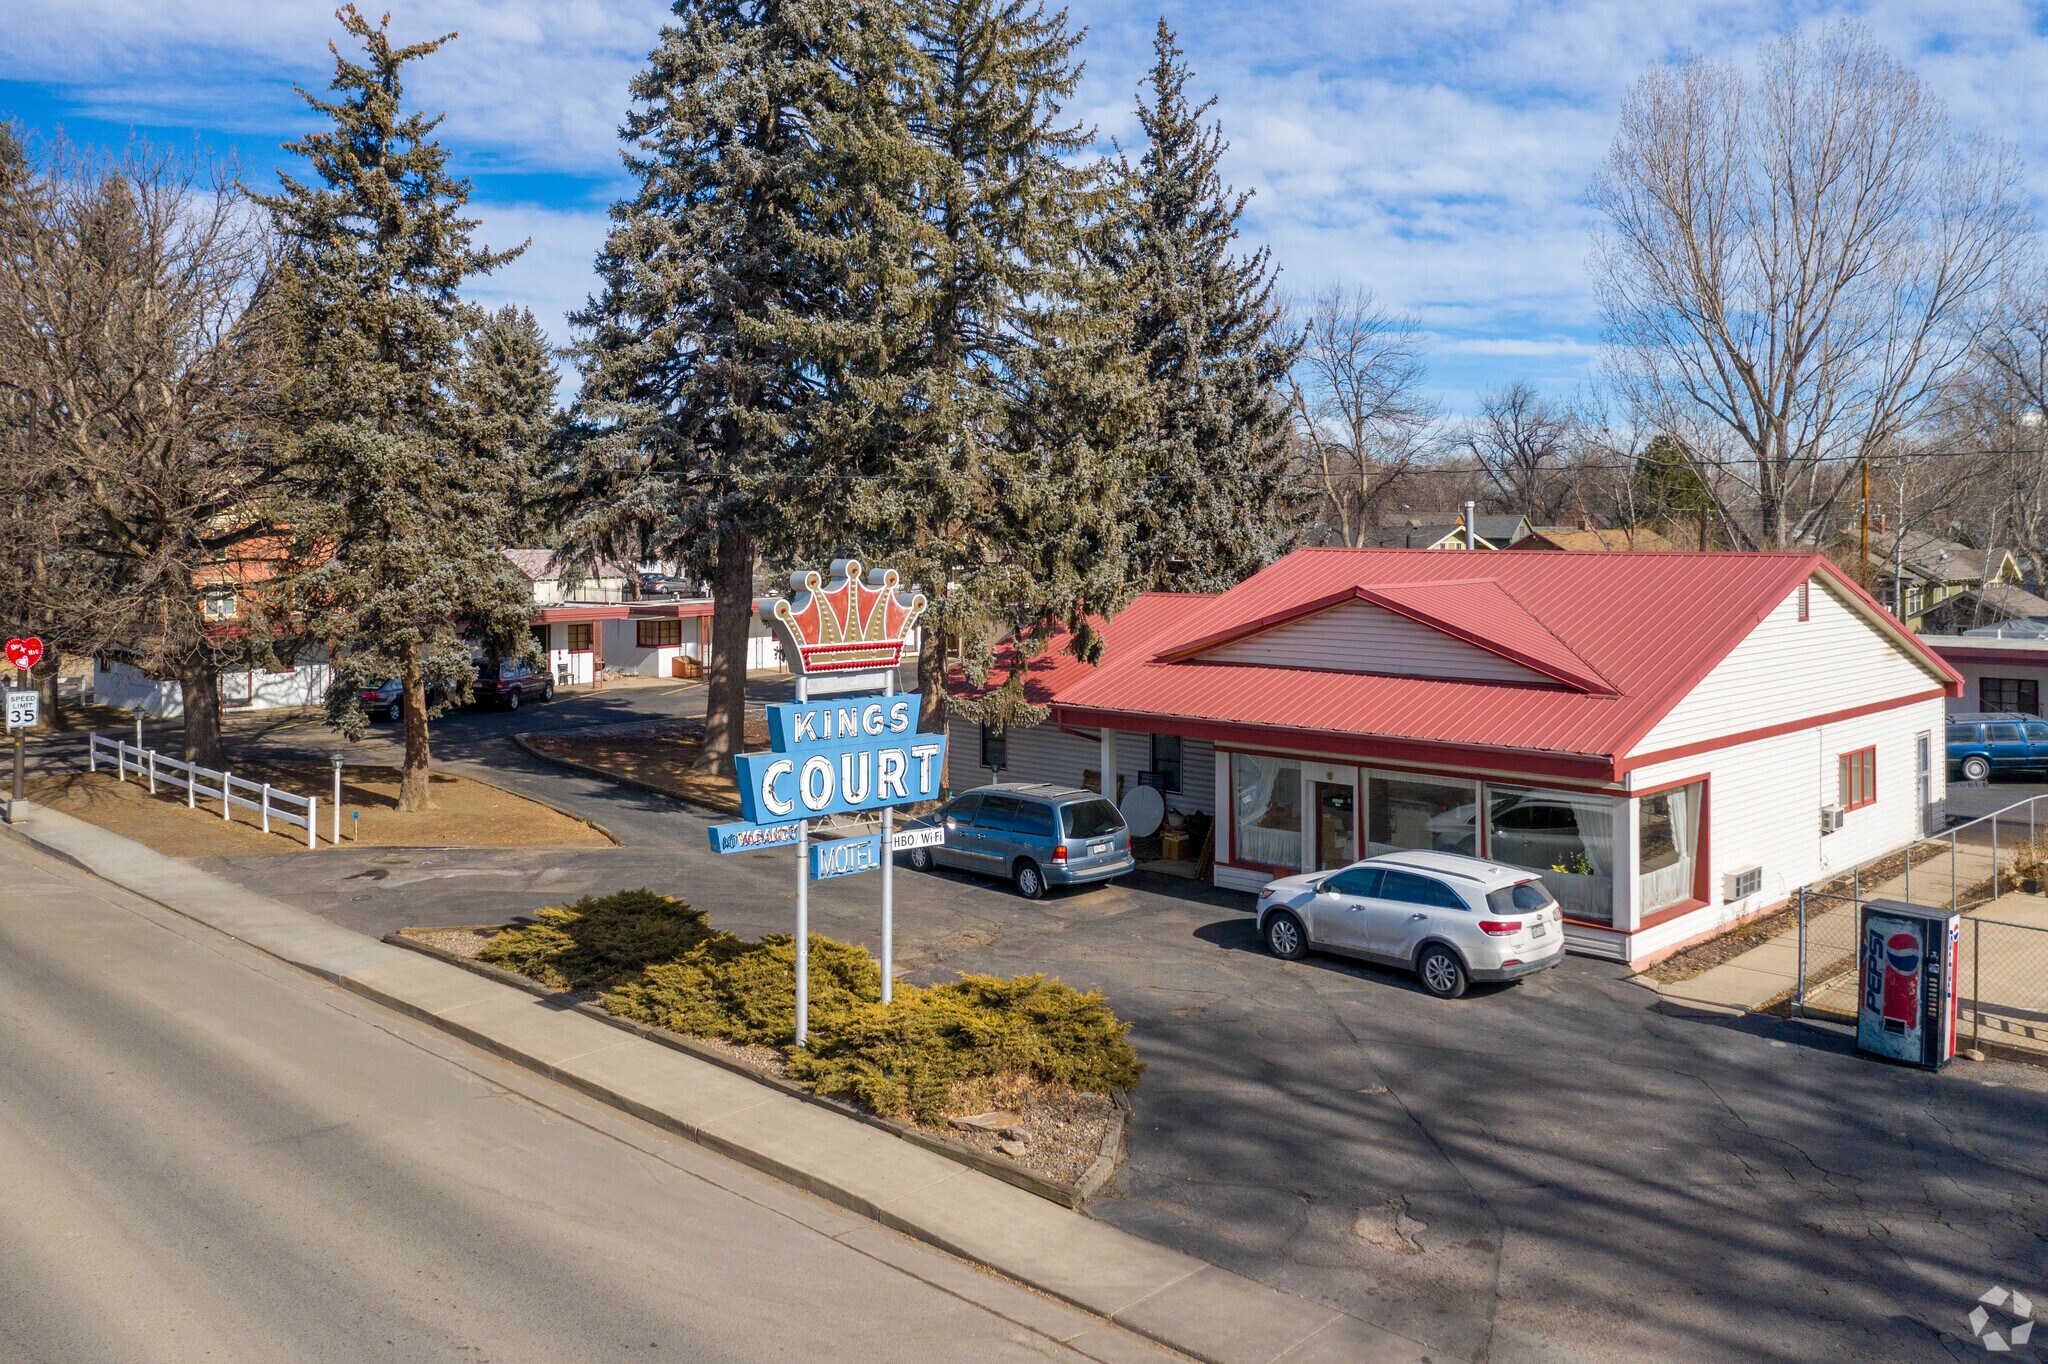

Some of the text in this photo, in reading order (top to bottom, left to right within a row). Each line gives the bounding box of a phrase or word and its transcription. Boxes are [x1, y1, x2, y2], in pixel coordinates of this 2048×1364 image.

[11, 710, 34, 722] 35
[794, 702, 909, 743] KINGS
[761, 743, 940, 816] COURT
[736, 823, 799, 848] VACANCY
[893, 834, 915, 848] HBO
[820, 840, 878, 877] MOTEL
[1866, 929, 1884, 1015] PEPSI
